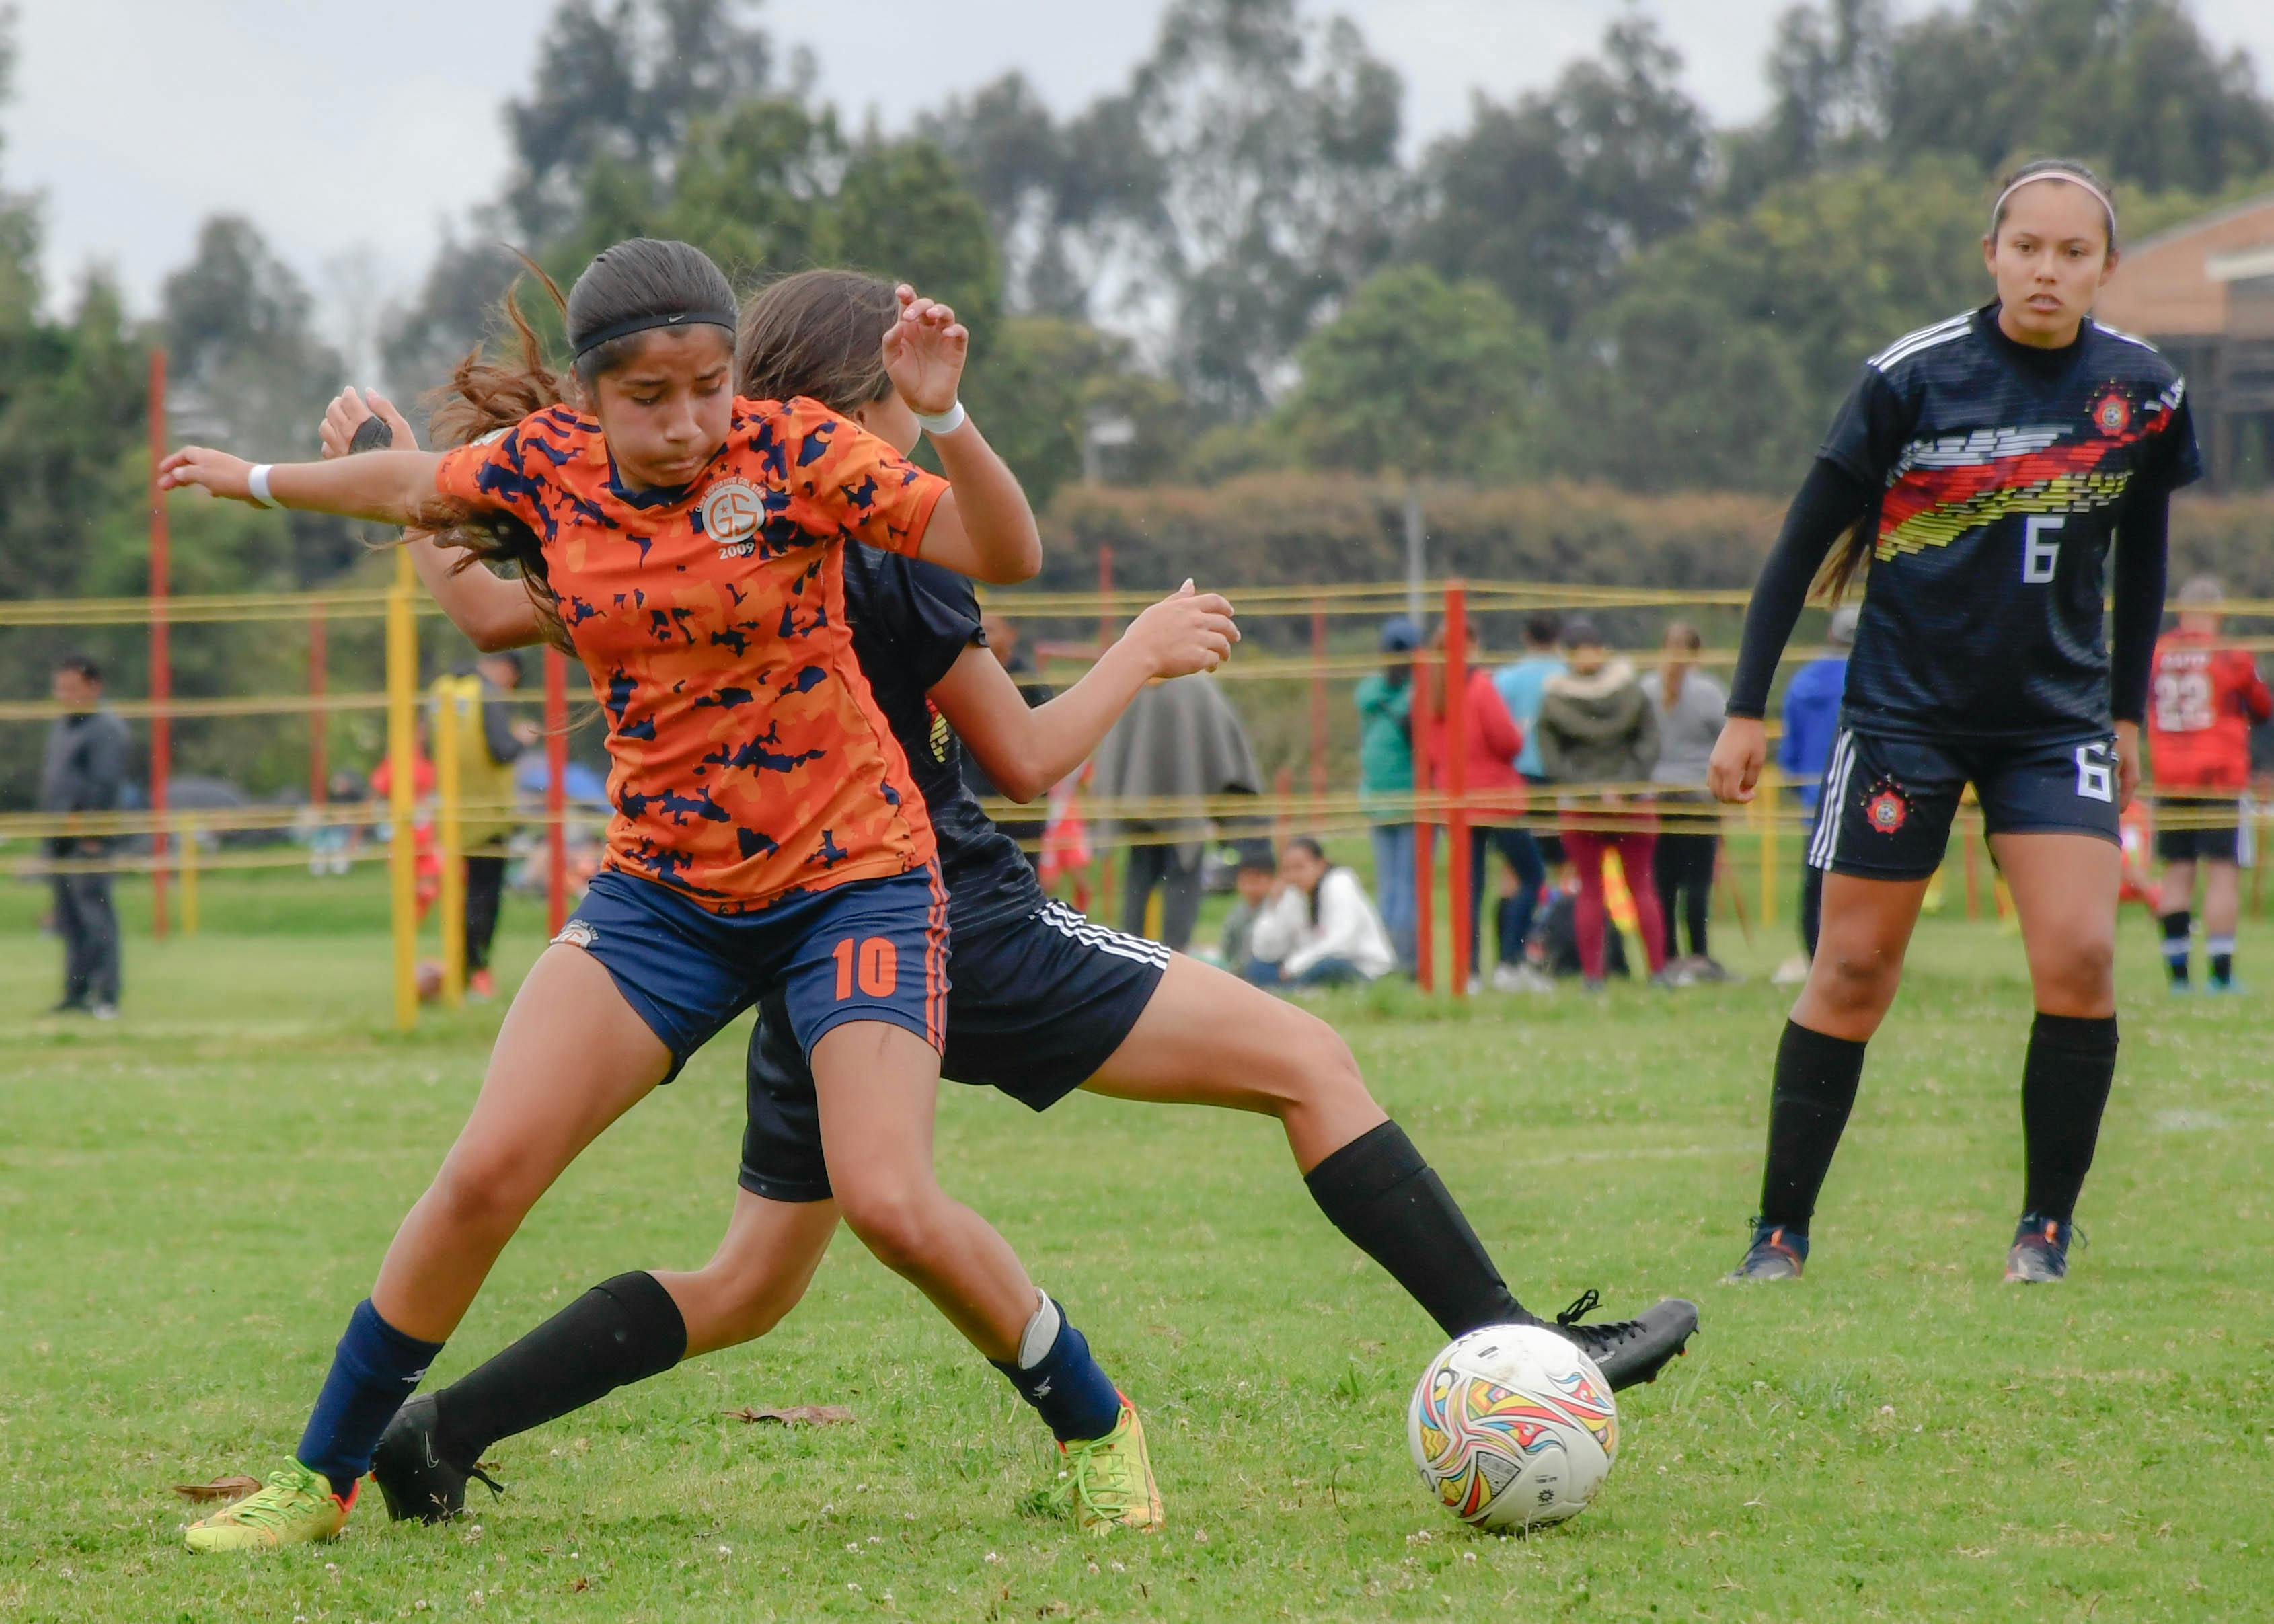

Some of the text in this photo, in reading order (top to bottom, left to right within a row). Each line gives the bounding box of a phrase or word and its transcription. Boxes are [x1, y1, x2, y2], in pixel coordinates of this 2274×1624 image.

[718, 542, 755, 559] 2009
[2023, 514, 2065, 584] 6
[2074, 743, 2112, 803] 6
[832, 936, 897, 1001] 10
